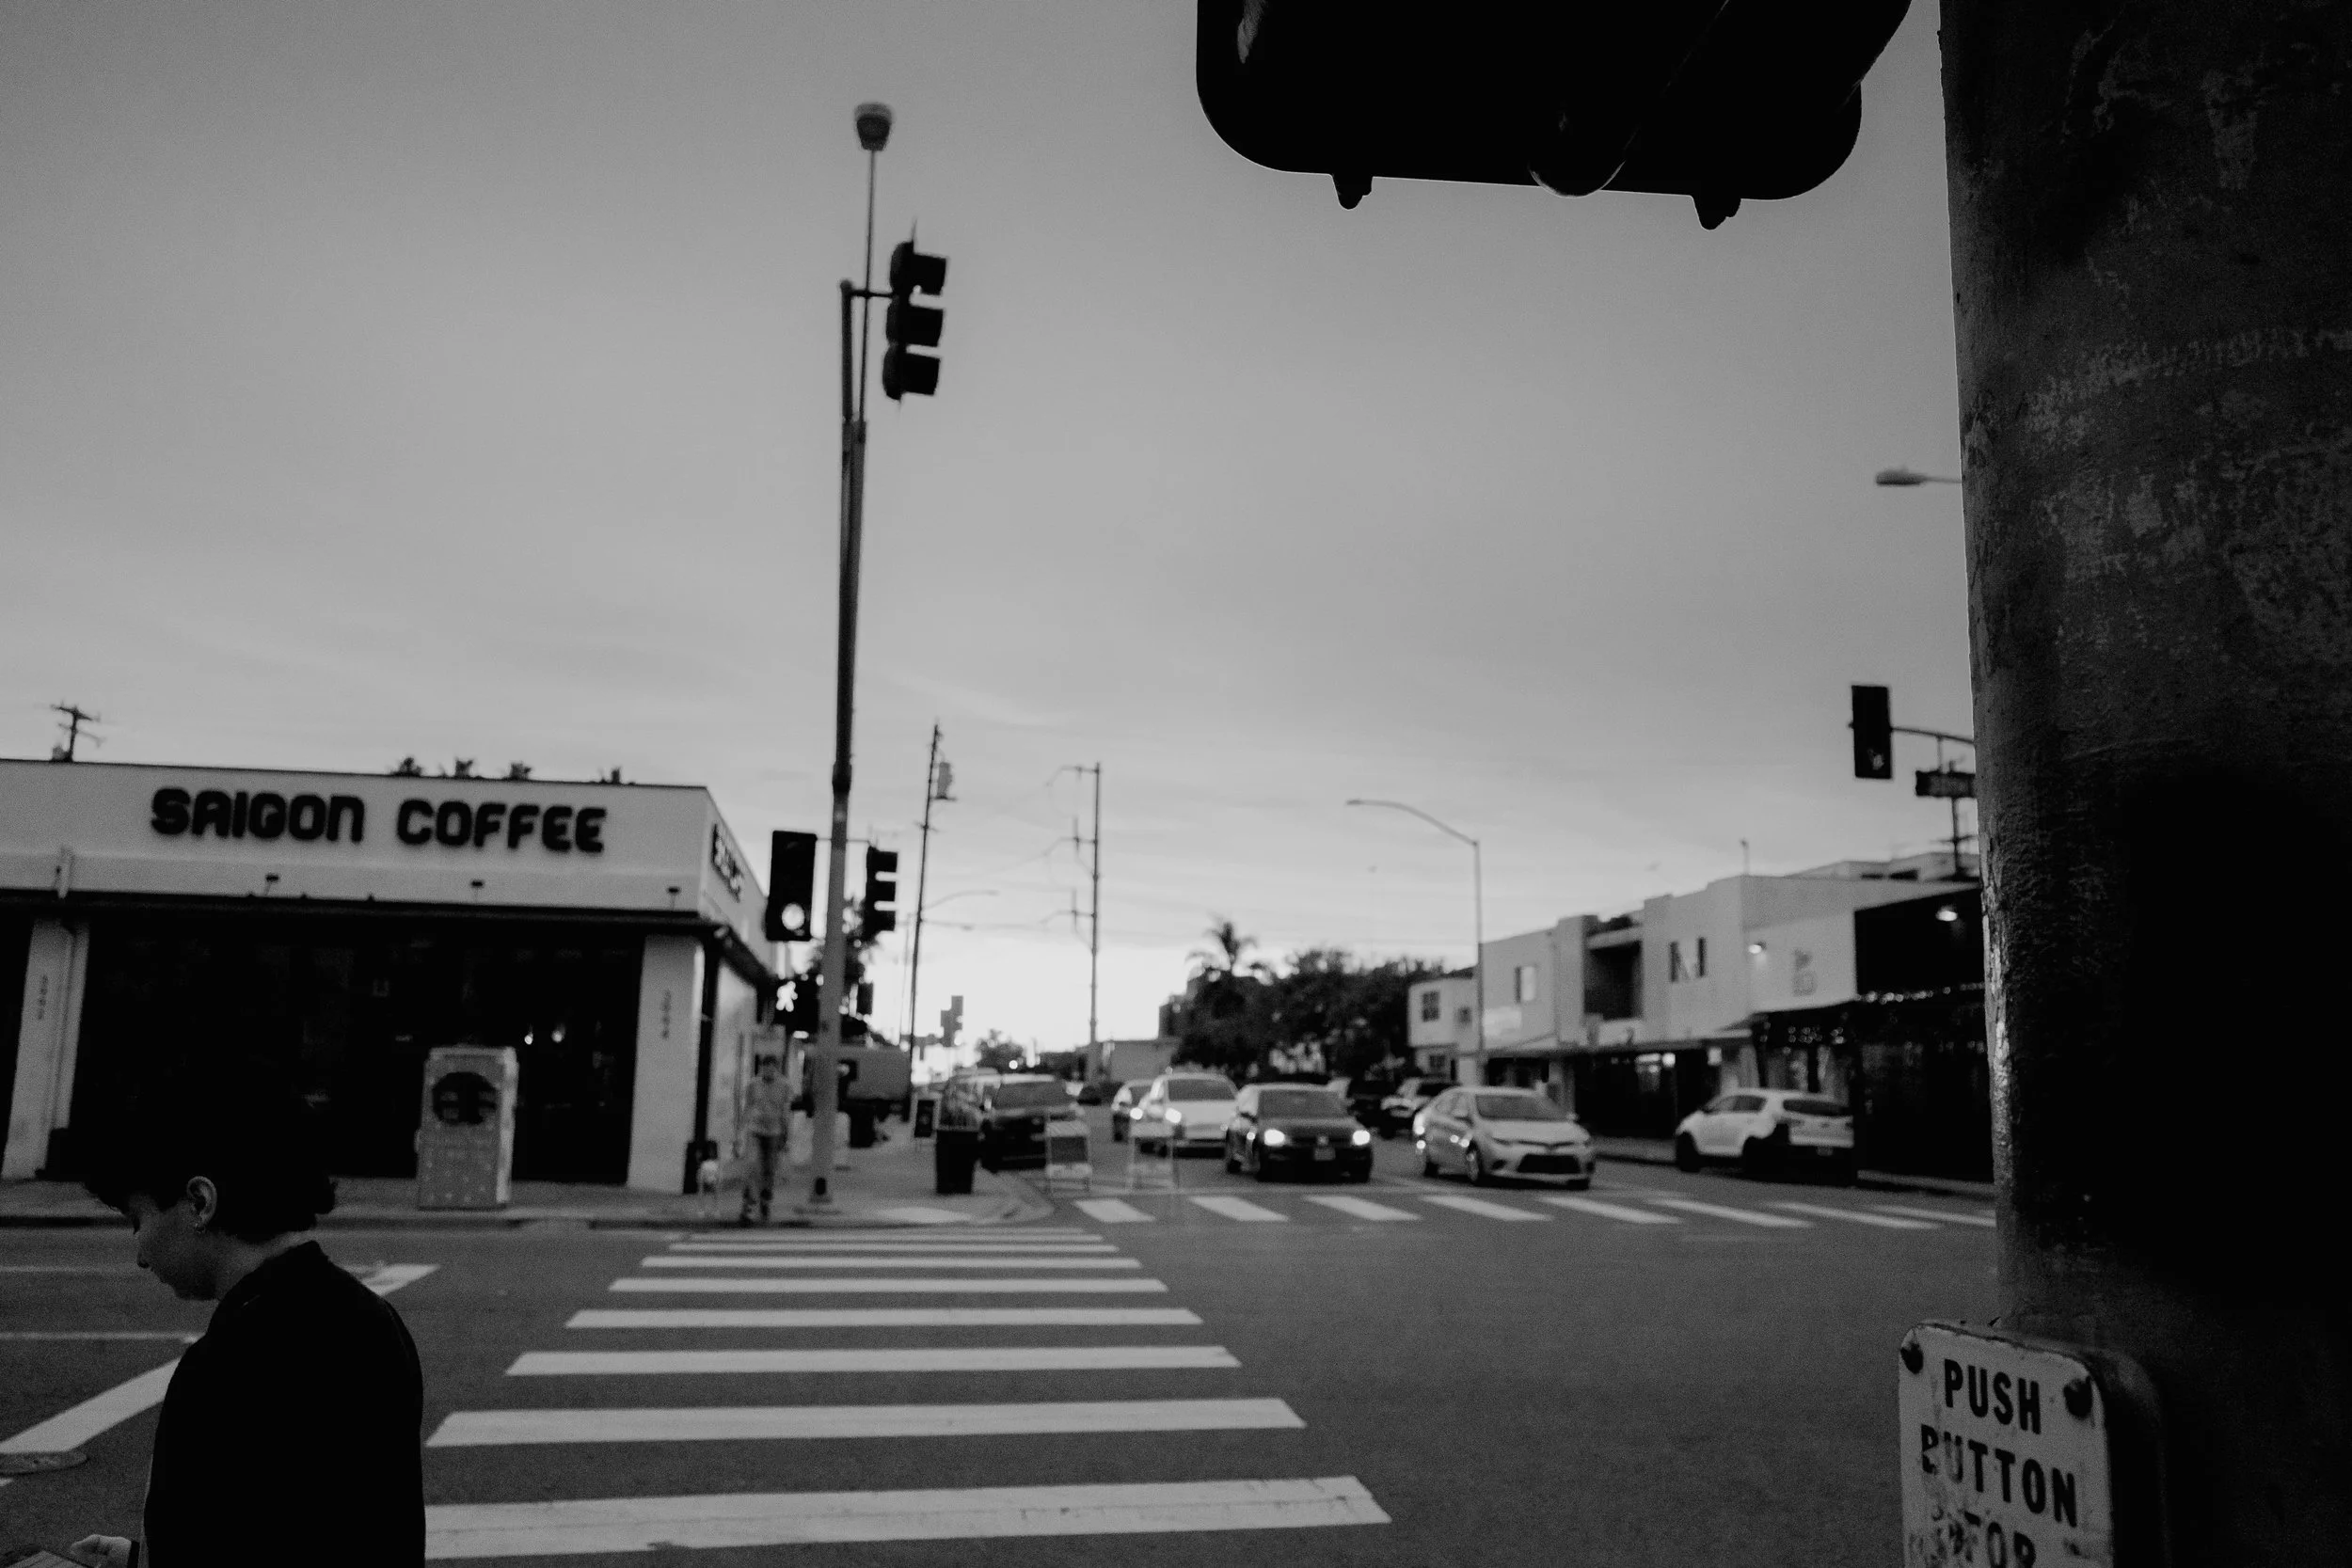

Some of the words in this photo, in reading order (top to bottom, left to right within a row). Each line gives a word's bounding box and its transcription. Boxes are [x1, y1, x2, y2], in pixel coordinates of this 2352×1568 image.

[151, 788, 365, 843] SAIGON
[397, 799, 606, 852] COFFEE
[1944, 1358, 2042, 1434] PUSH
[1921, 1423, 2077, 1528] BUTTON
